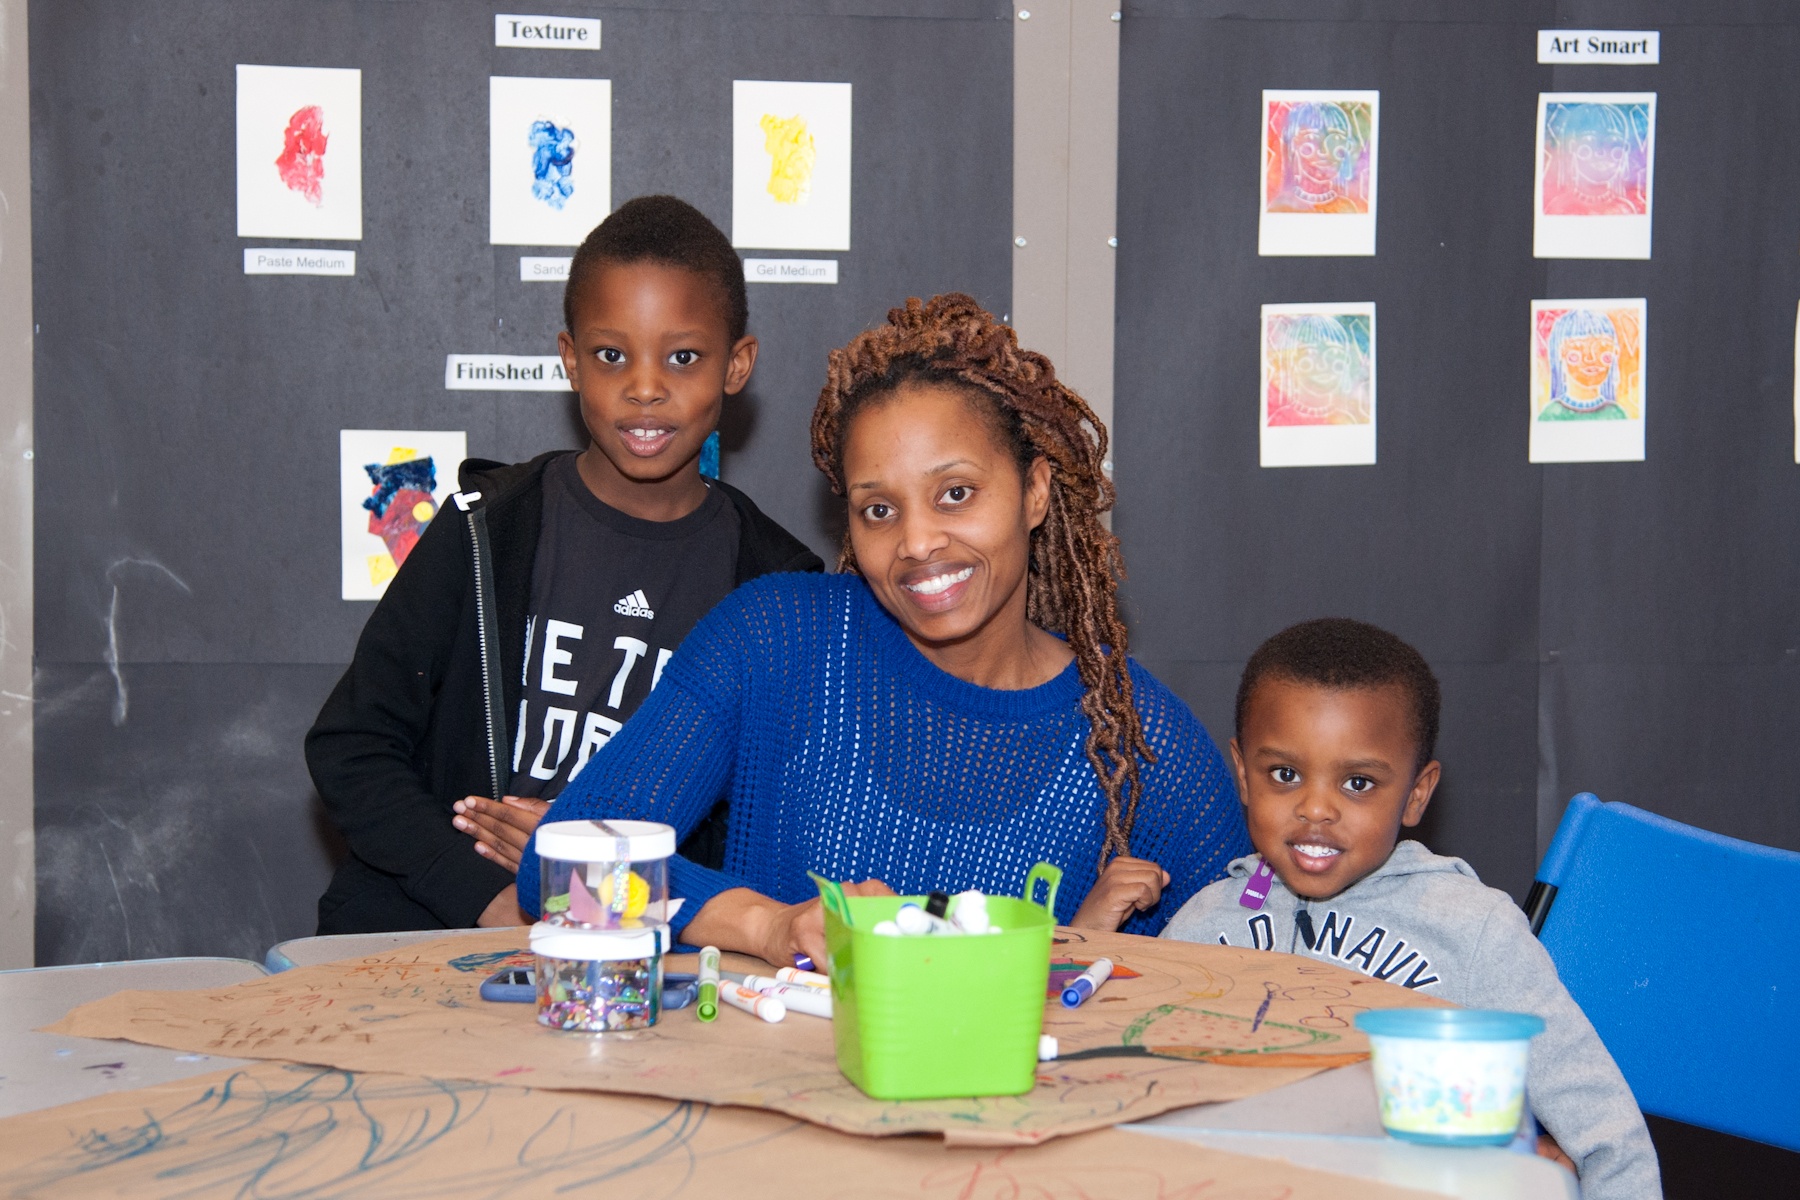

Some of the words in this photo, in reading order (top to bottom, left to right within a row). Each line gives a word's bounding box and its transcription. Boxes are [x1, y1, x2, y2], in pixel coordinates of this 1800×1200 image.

[508, 20, 588, 41] Texture
[1550, 36, 1579, 54] Art
[1587, 36, 1648, 54] Smart
[257, 255, 293, 268] Paste
[296, 256, 346, 269] Medium
[533, 263, 564, 275] Sand
[756, 264, 777, 276] Gel
[780, 265, 827, 277] Medium
[456, 362, 544, 381] Finished
[551, 363, 570, 381] A
[613, 603, 655, 620] adidas
[520, 614, 584, 697] E
[1312, 910, 1442, 991] NAVY
